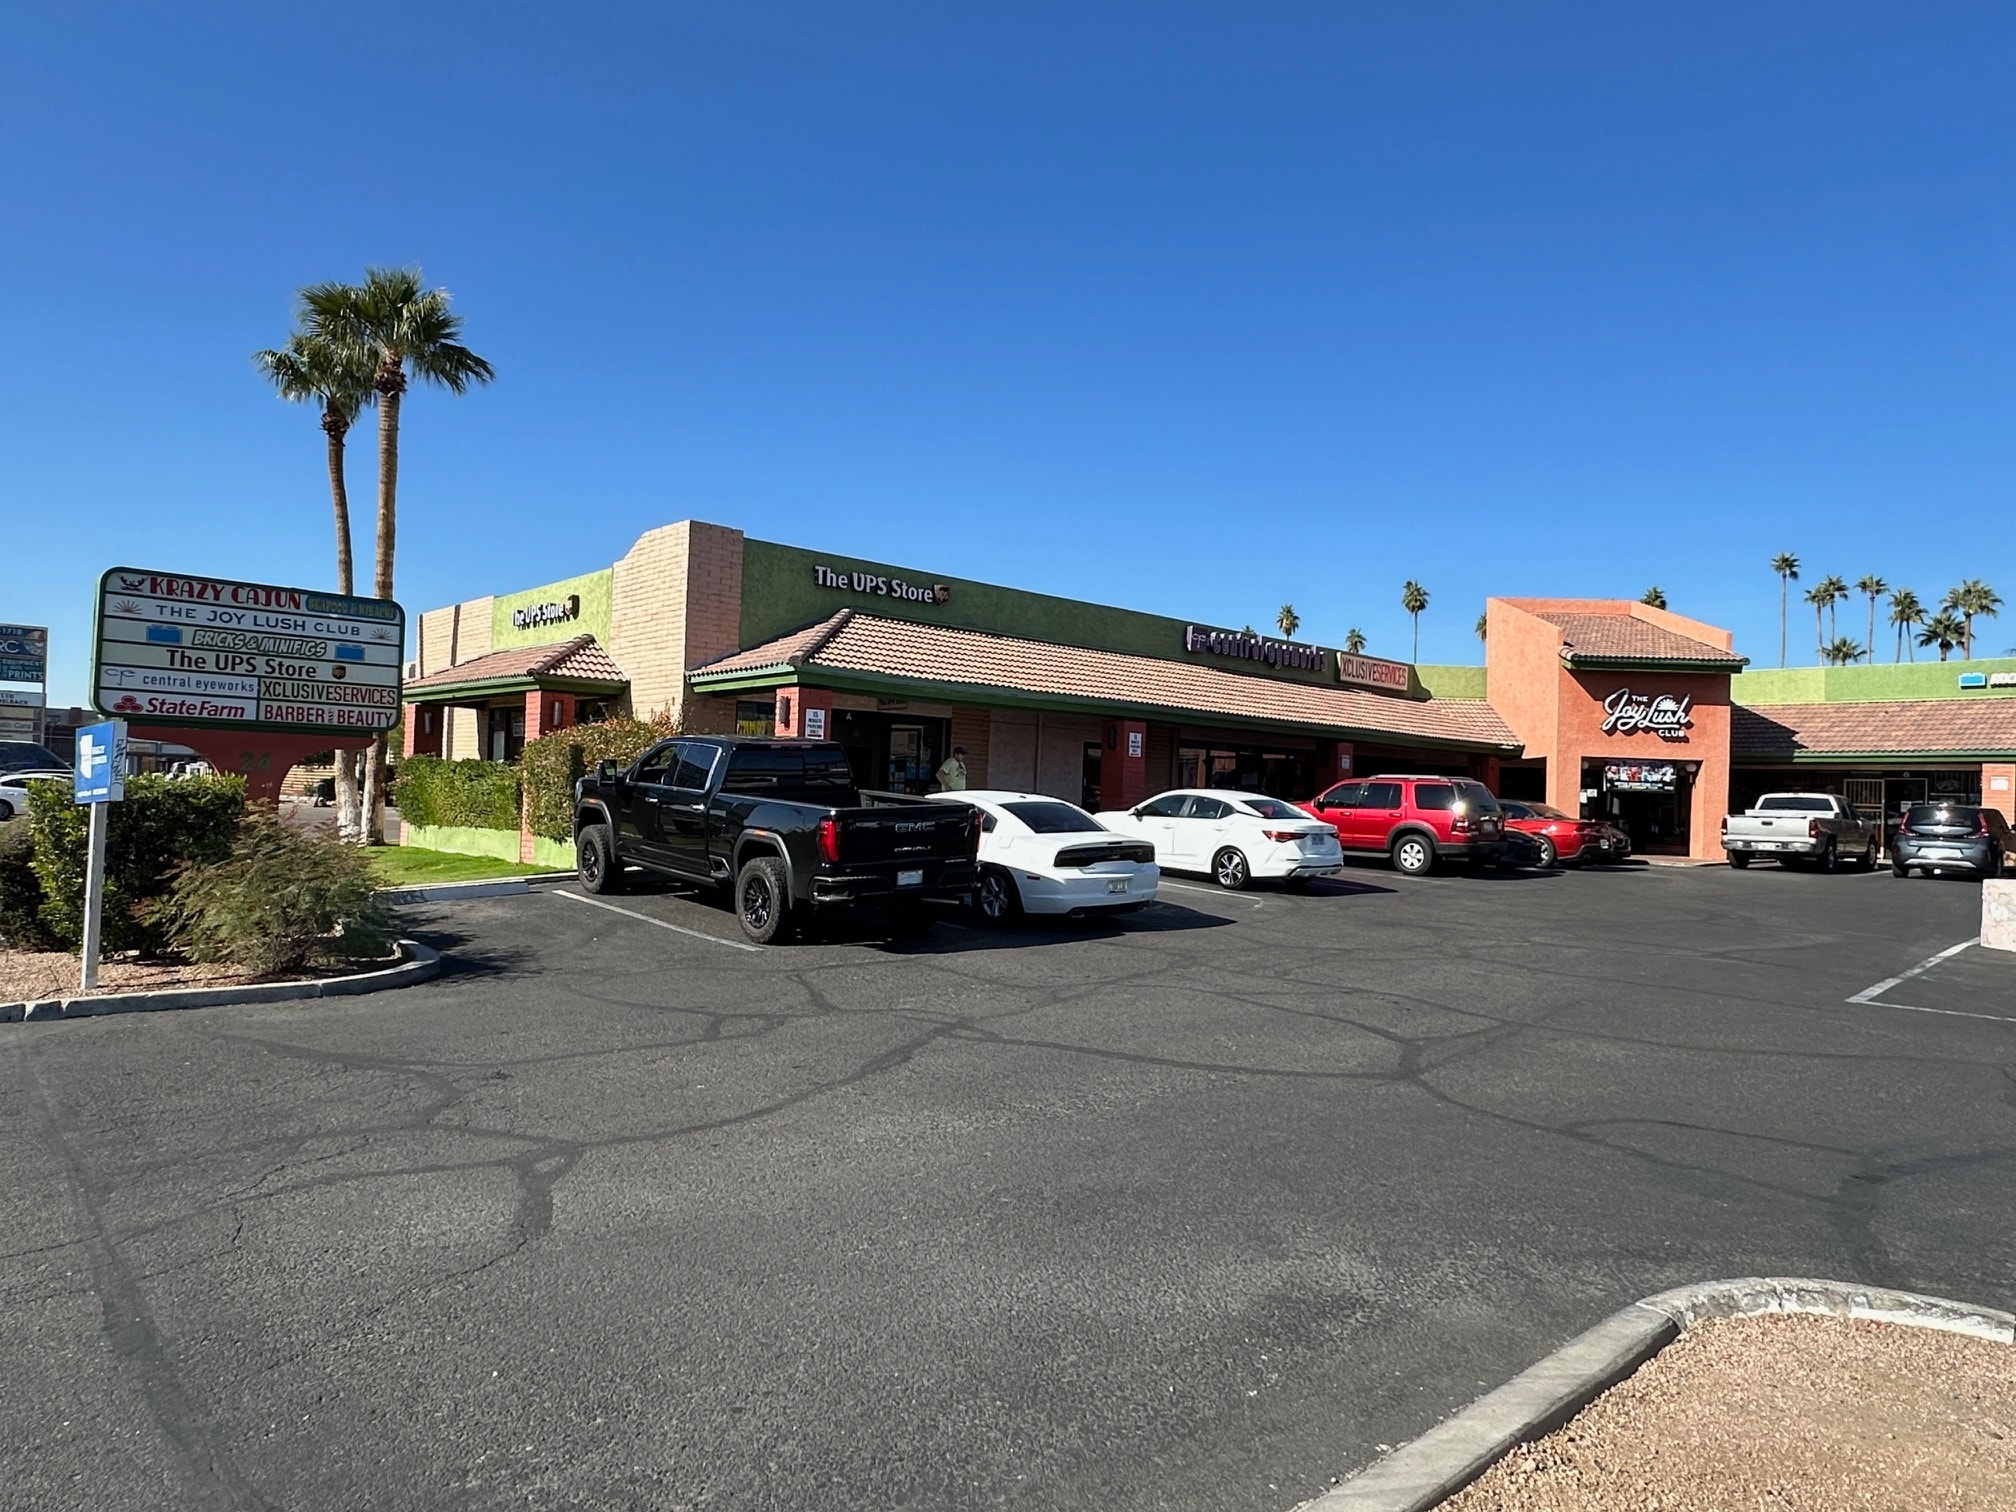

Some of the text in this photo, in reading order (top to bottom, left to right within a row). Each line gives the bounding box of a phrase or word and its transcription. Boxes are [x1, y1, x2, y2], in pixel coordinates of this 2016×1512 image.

[150, 577, 300, 610] KRAZY CAJUN
[815, 566, 933, 602] The UPS Store
[155, 604, 360, 636] THE JOY LUSH CLUB
[192, 629, 327, 658] BRICKS & MINIFIGS
[8, 670, 44, 680] PRINTS
[166, 649, 318, 679] The UPS Store
[1342, 657, 1407, 686] XCLUSIVESERVICES
[142, 674, 255, 693] central eyeworks
[262, 680, 396, 706] XCLUSIVESERVICES
[1601, 687, 1691, 731] Joy Lush
[1632, 694, 1649, 702] THE
[264, 704, 326, 723] BARBER
[337, 709, 393, 727] BEAUTY
[1658, 729, 1685, 737] CLUB
[238, 751, 273, 772] 24
